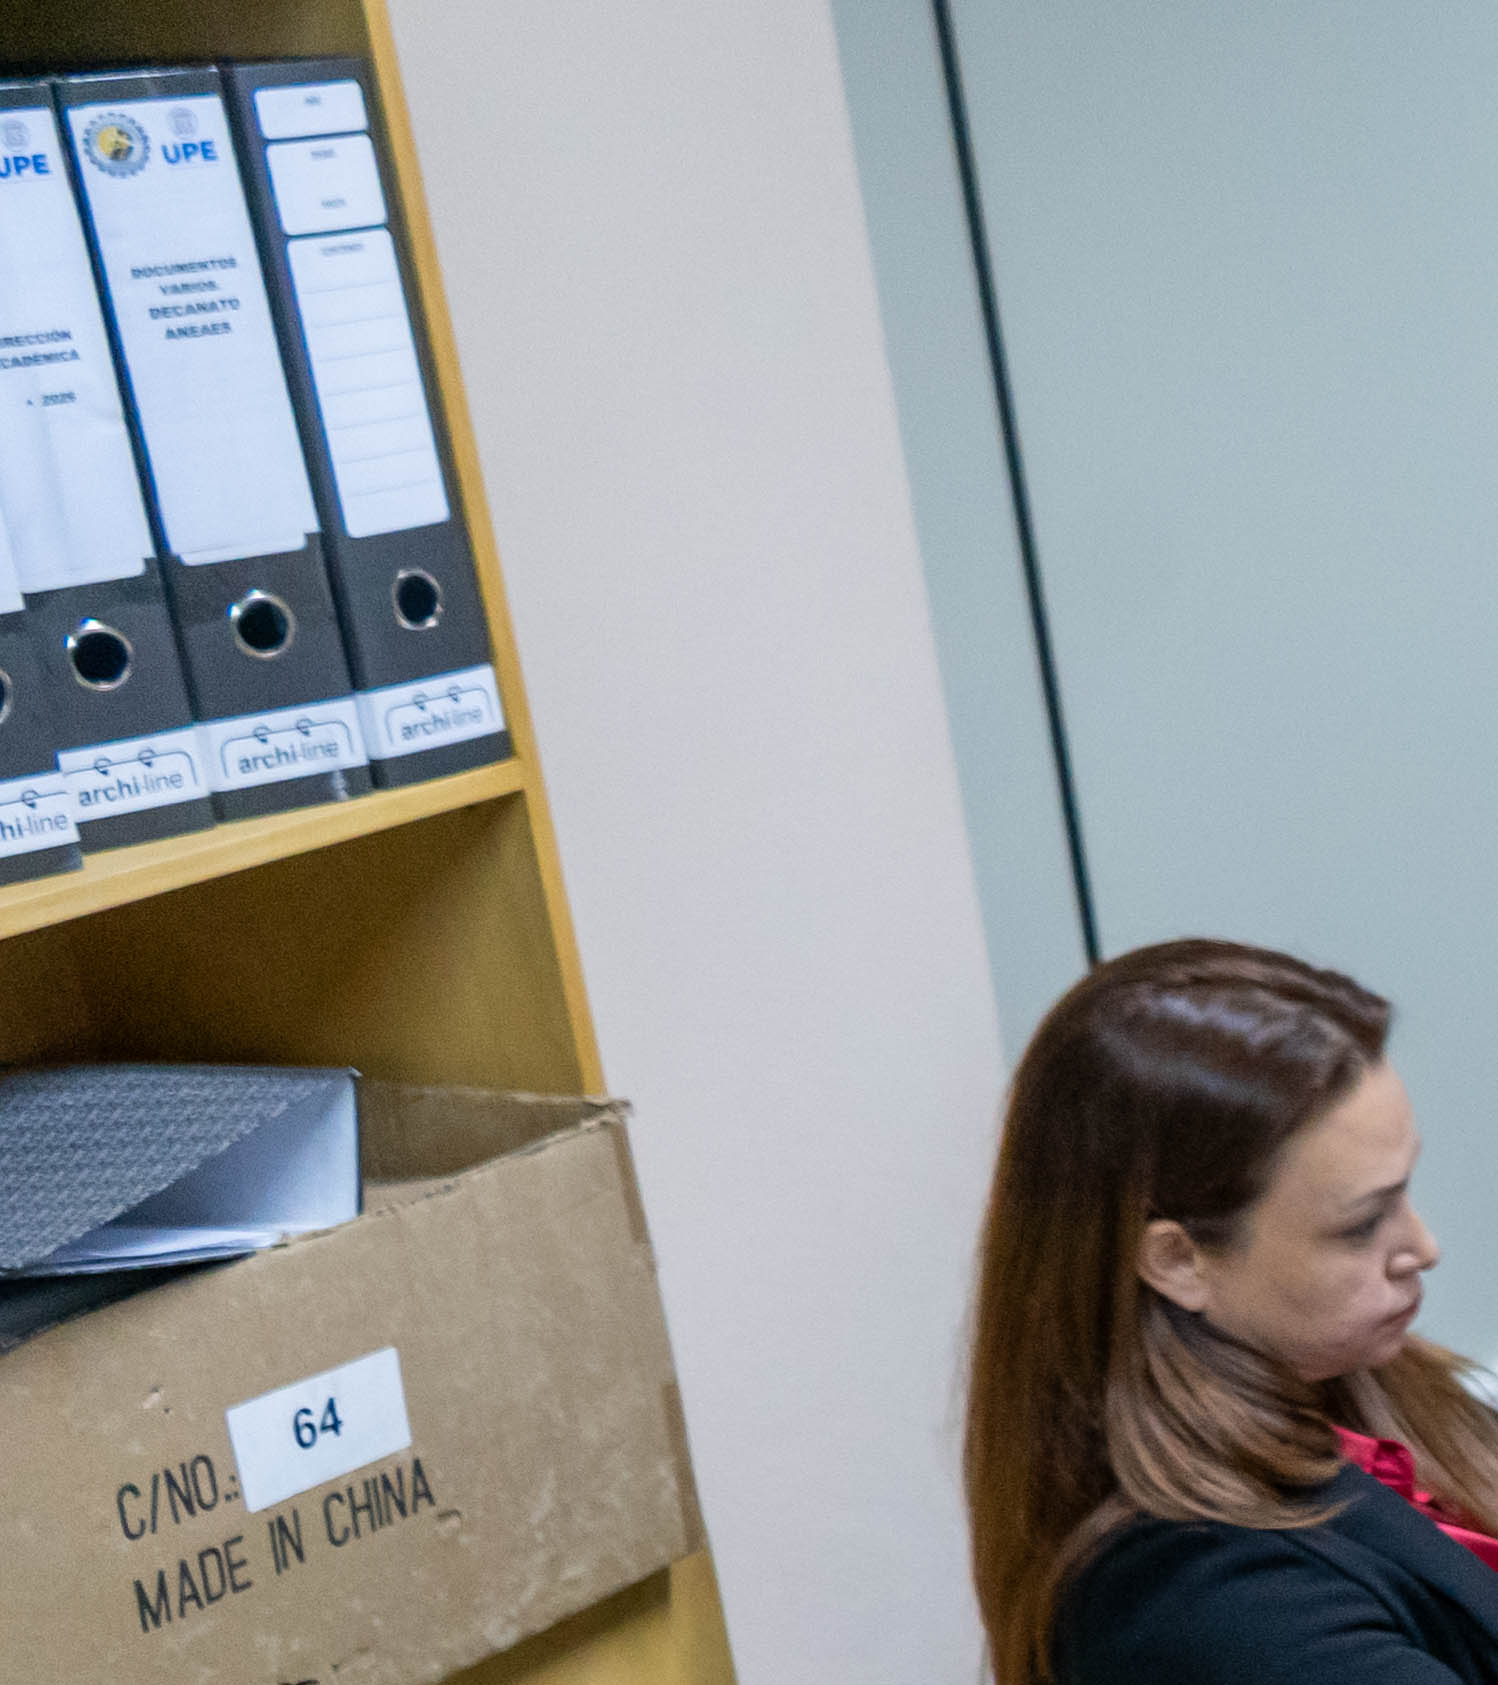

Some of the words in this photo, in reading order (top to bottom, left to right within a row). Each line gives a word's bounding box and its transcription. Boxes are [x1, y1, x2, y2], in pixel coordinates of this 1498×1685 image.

[162, 141, 219, 164] UPE
[131, 257, 237, 279] DOCUMENTOS
[148, 298, 240, 320] DECANATO
[238, 740, 340, 774] archi-line
[79, 772, 184, 807] archi-line
[0, 814, 69, 841] hi-line
[293, 1397, 343, 1449] 64
[133, 1535, 254, 1634] MADE
[267, 1508, 306, 1576] IN
[322, 1457, 436, 1548] CHINA
